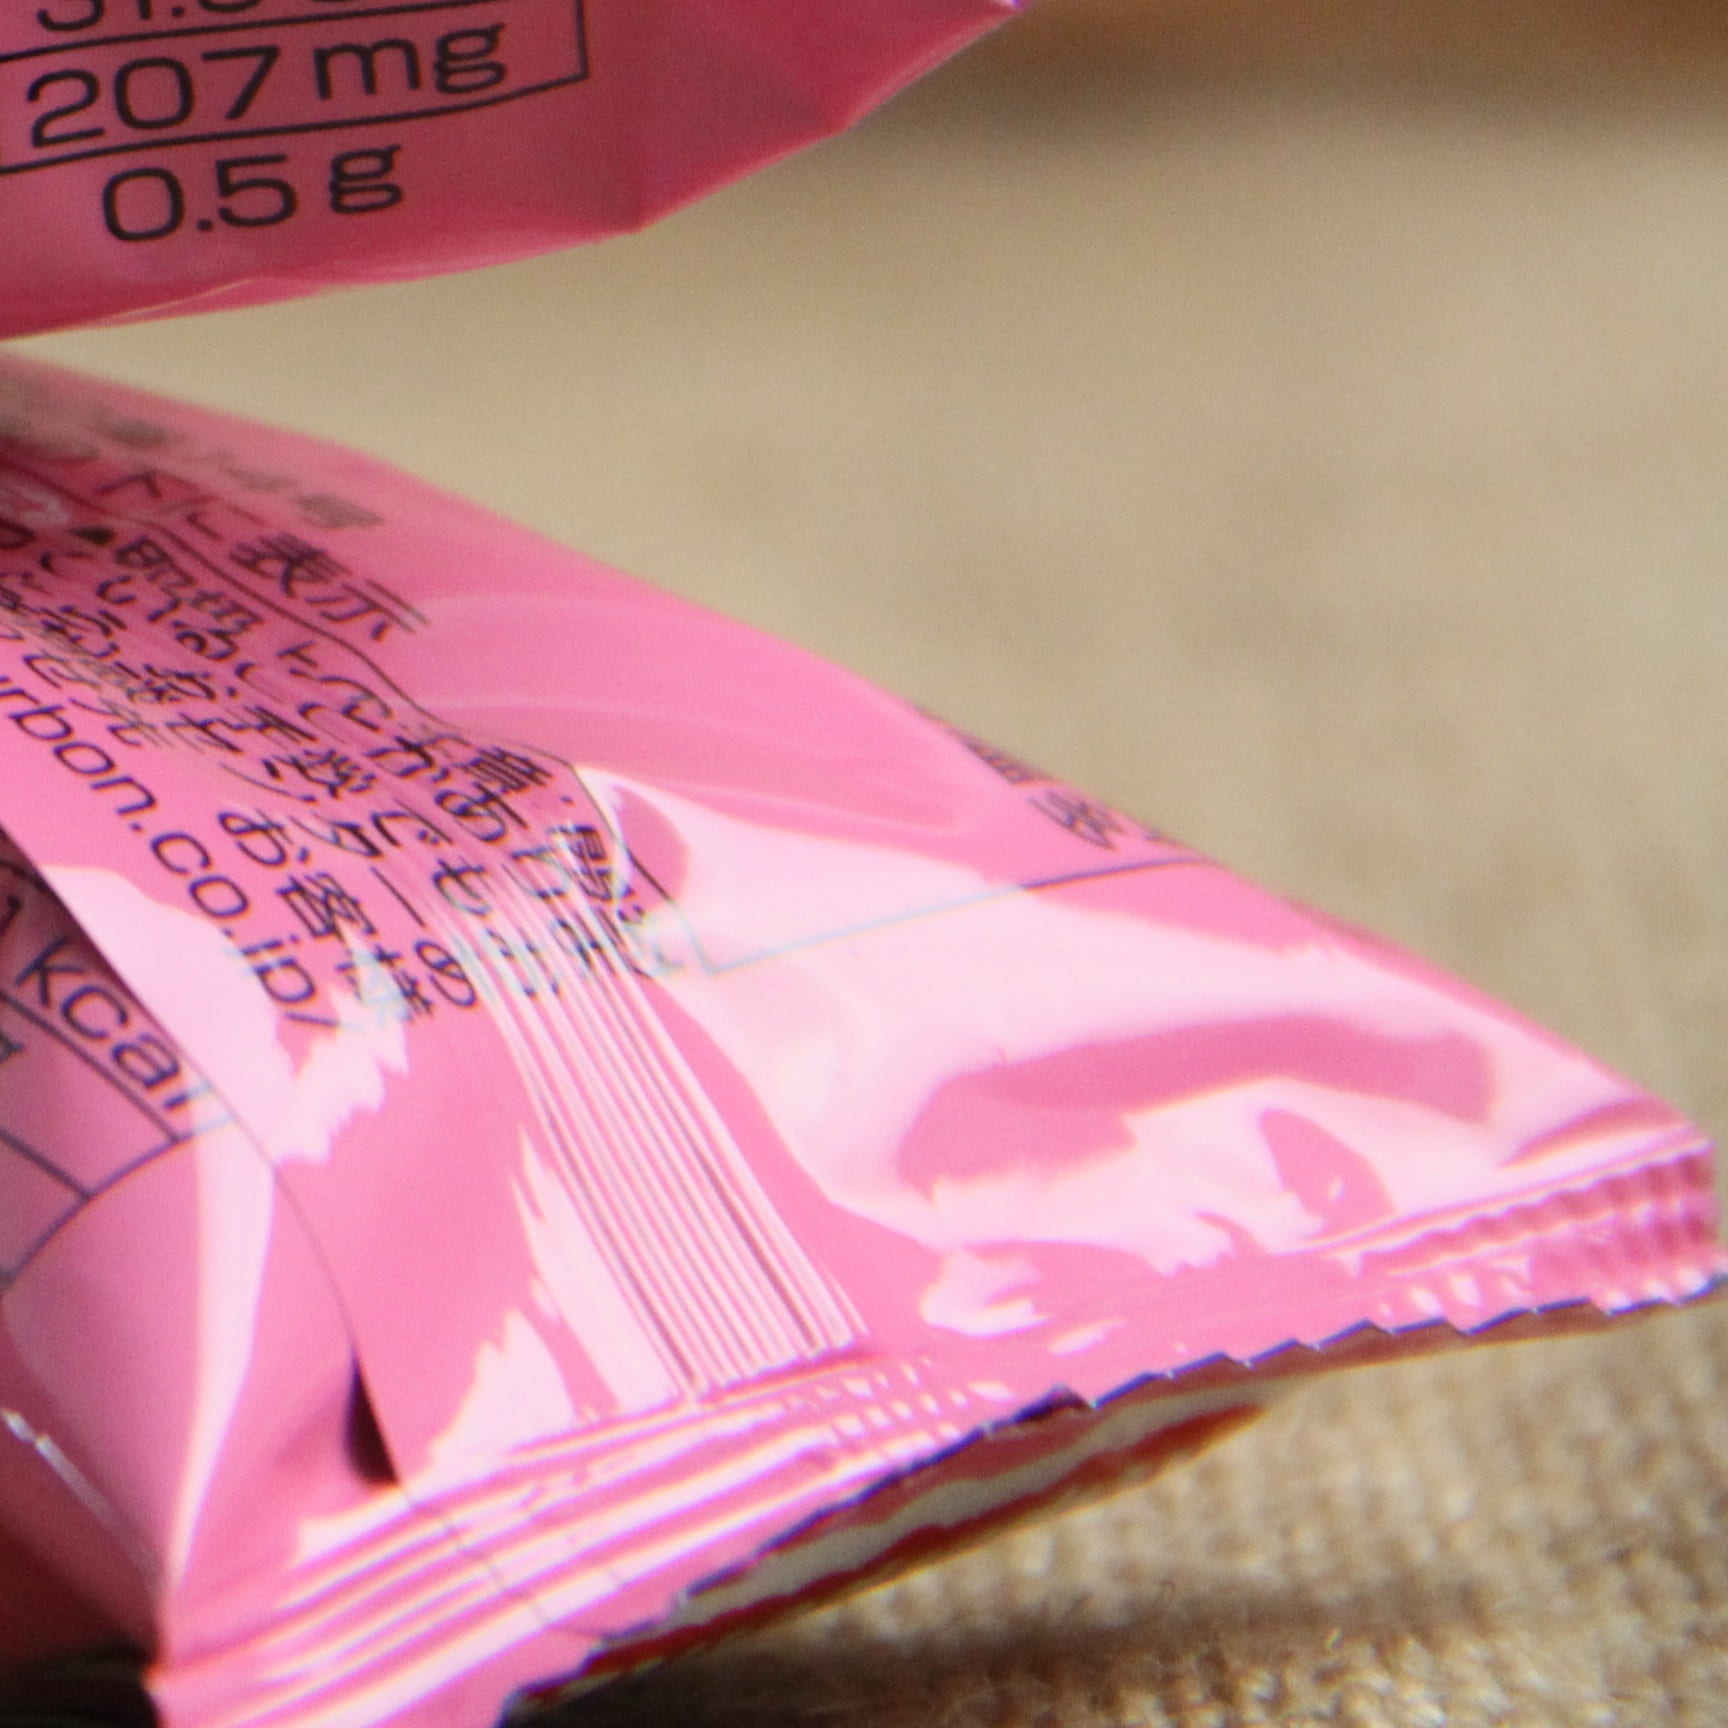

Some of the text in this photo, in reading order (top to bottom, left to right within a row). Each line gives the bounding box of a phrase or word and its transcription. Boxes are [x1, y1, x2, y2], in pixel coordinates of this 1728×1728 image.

[26, 51, 285, 150] 207
[313, 19, 507, 103] mg
[104, 153, 297, 245] 0.5
[325, 138, 404, 213] g
